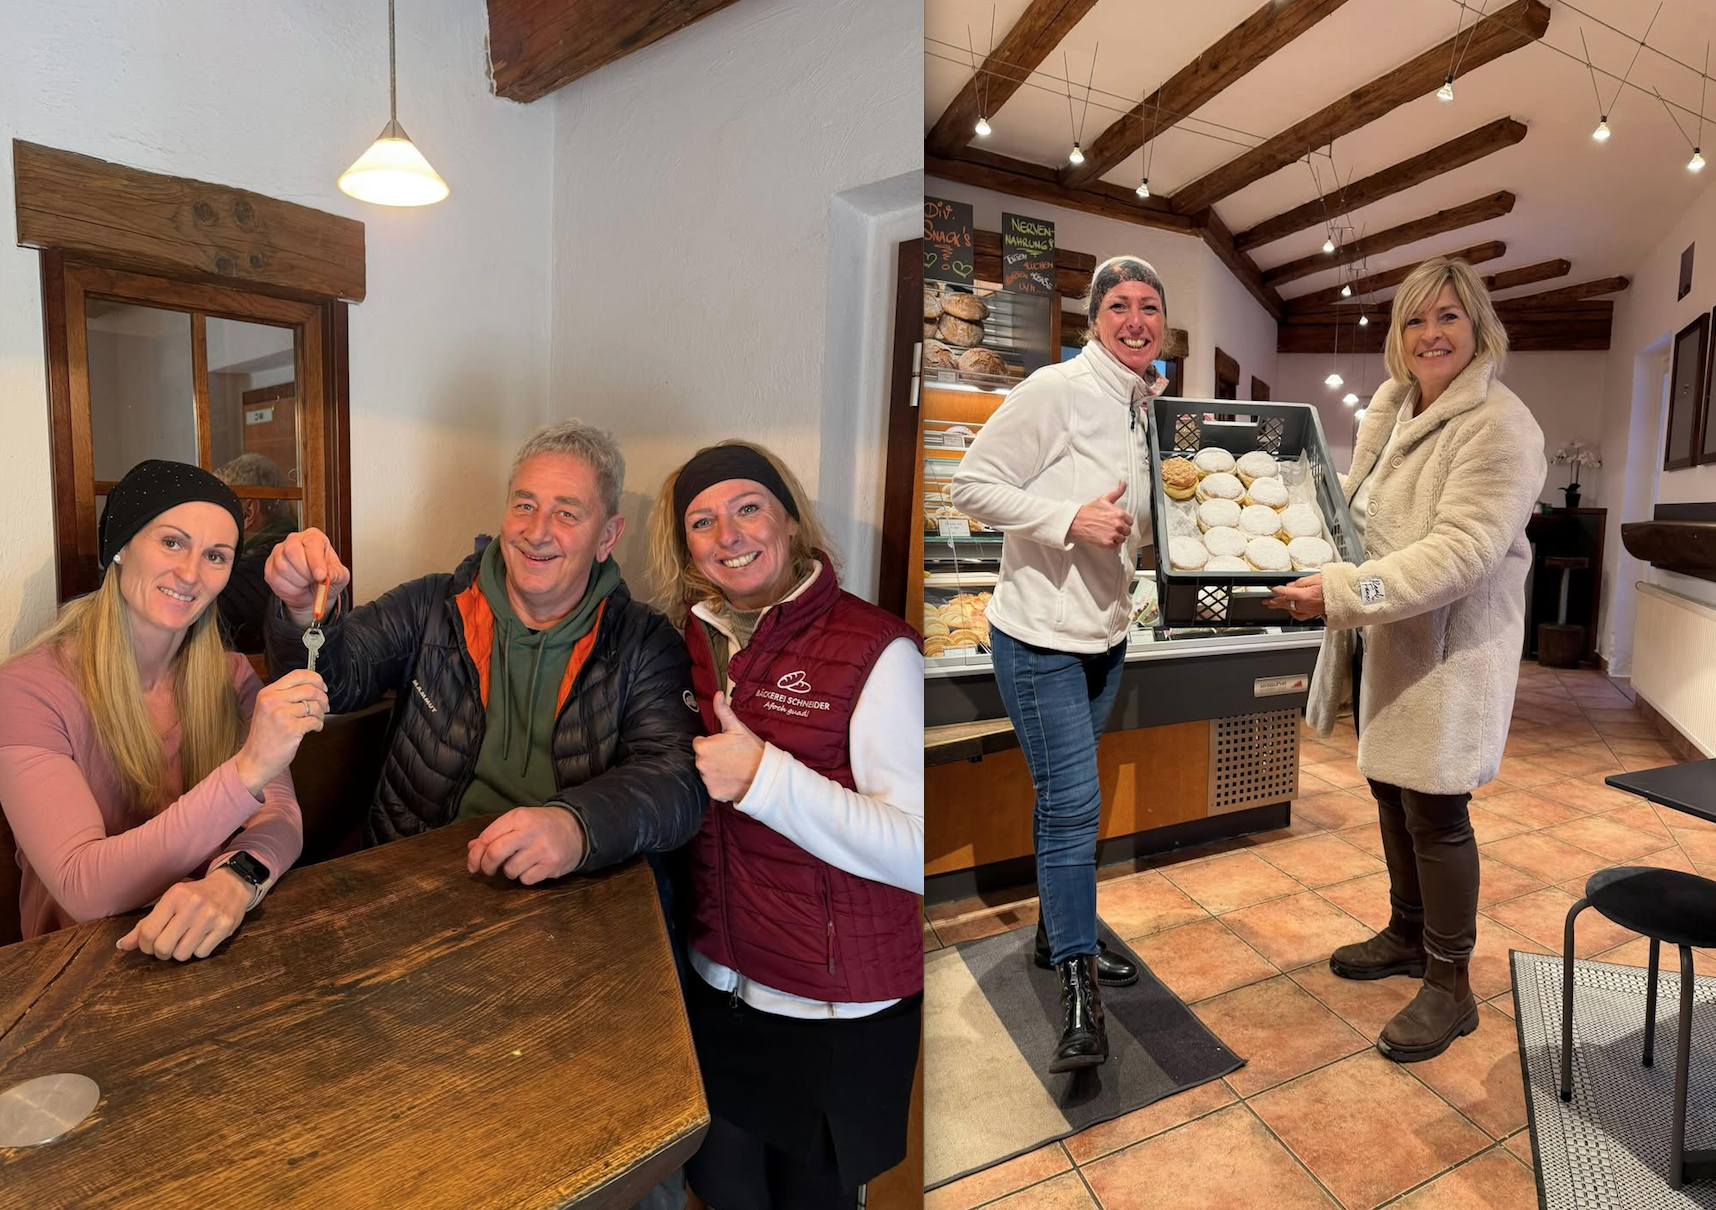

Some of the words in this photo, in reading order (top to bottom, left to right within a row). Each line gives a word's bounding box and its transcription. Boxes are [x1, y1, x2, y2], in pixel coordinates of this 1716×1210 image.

[412, 680, 437, 712] MAMMUT
[755, 688, 787, 702] BÄCKEREI
[787, 696, 830, 711] SCHNEIDER
